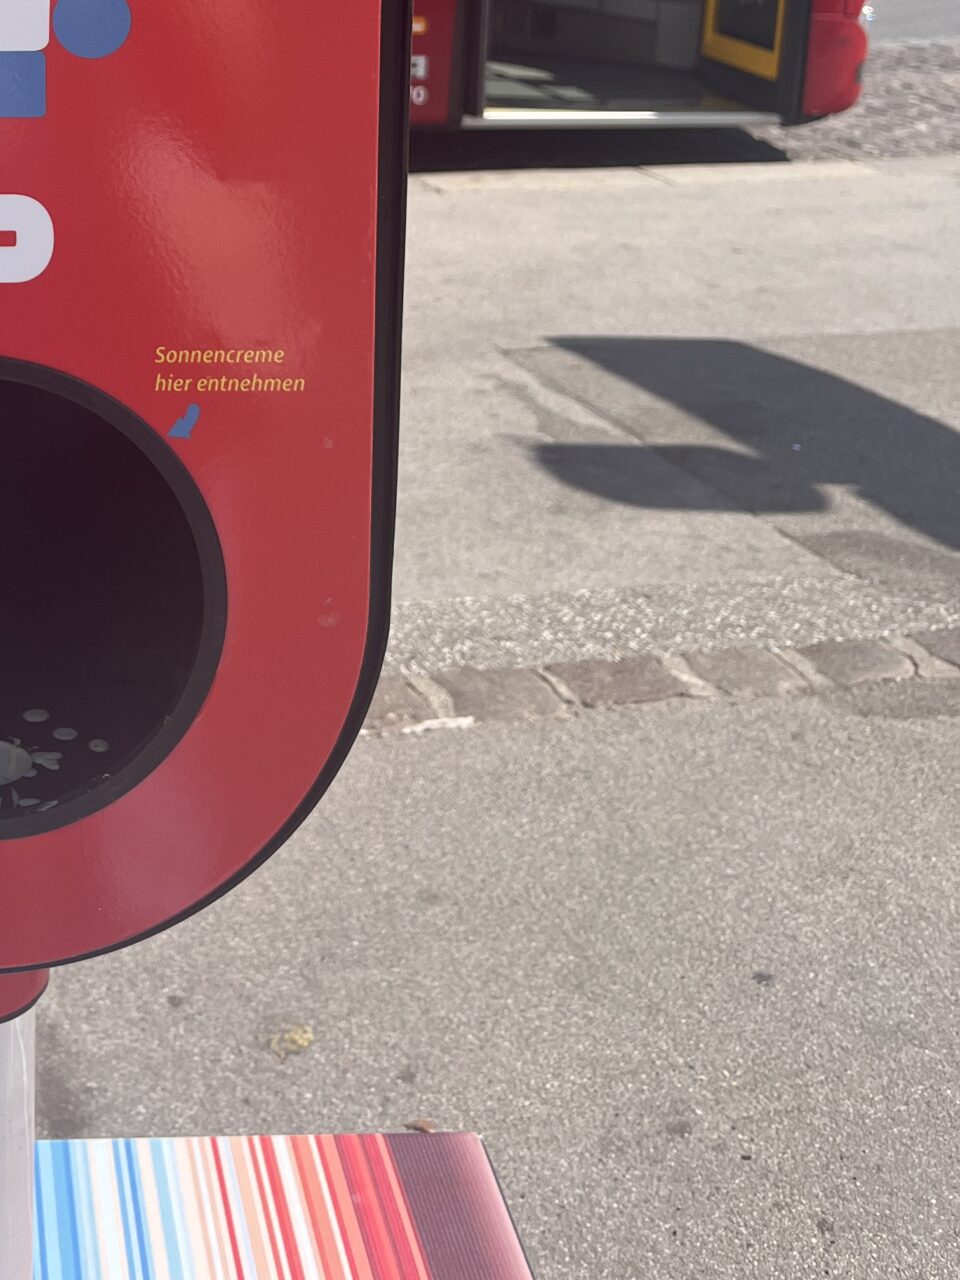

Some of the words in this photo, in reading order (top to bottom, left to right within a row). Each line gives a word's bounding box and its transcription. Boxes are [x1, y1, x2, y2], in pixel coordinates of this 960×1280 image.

[155, 346, 284, 363] Sonnencreme
[154, 373, 192, 392] hier
[196, 373, 306, 392] entnehmen
